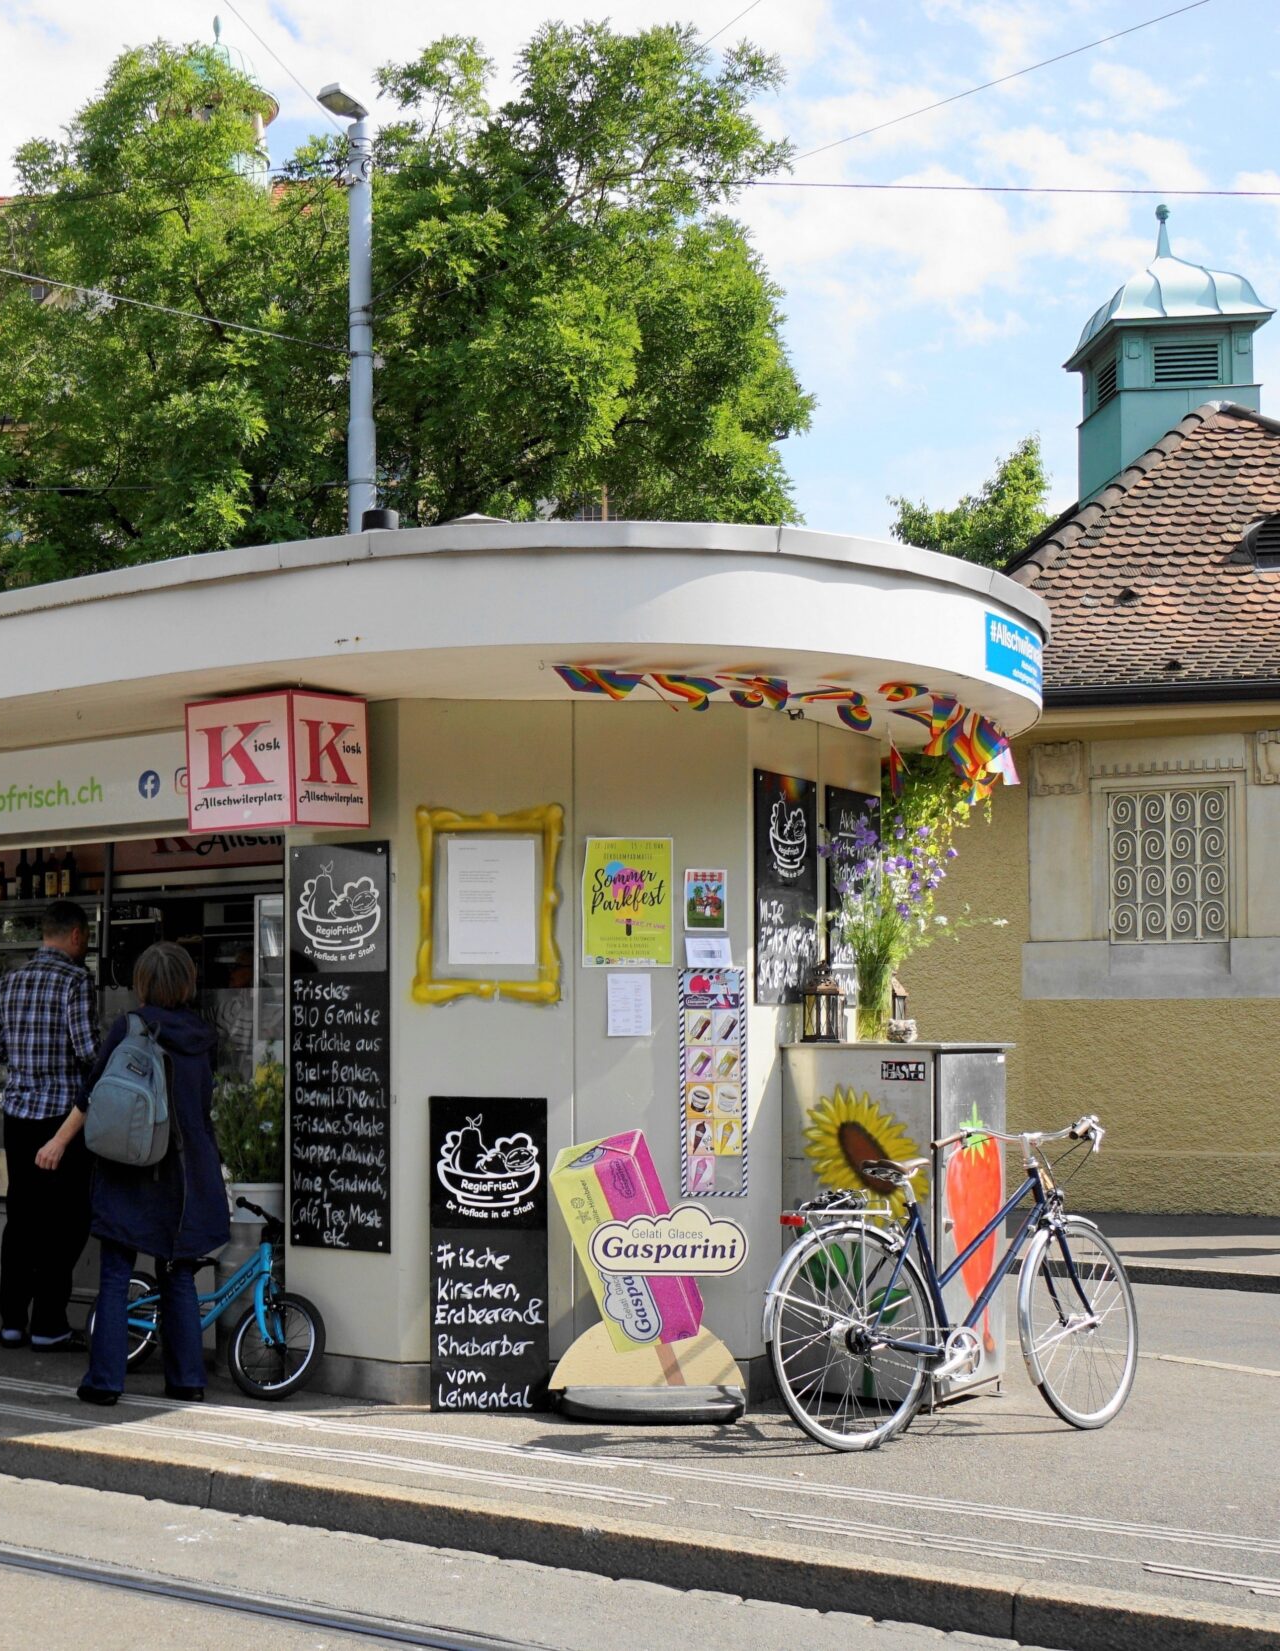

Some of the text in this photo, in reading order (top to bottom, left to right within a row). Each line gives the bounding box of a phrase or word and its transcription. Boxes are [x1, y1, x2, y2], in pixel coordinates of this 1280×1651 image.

[196, 720, 280, 789] Kiosk
[299, 719, 362, 785] Kiosk
[194, 792, 283, 812] Allschwilerplatz
[299, 790, 364, 806] Allschwilerplatz
[592, 868, 657, 893] Sommer
[591, 880, 665, 915] Parkfest
[316, 922, 363, 938] RegioFrisch
[304, 943, 376, 961] Dr Hoflade in dr Stadt
[293, 979, 351, 1000] Frisches
[292, 1002, 381, 1027] BIO Gemüse
[292, 1029, 382, 1054] & Früchte aus
[293, 1113, 385, 1137] Frische Salate
[460, 1178, 519, 1194] RegioFrisch
[349, 1203, 382, 1228] Most
[446, 1199, 535, 1218] Dr Hoflade in dr Stadt
[631, 1228, 704, 1239] Gelati Glaces
[436, 1241, 511, 1270] Frische
[602, 1236, 737, 1264] Gasparini
[437, 1277, 521, 1303] Kirschen,
[612, 1275, 624, 1296] Glace
[434, 1298, 545, 1325] Erdbeeren &
[622, 1275, 652, 1333] Gaspa
[437, 1333, 535, 1357] Rhabarber
[446, 1368, 487, 1385] vom
[438, 1383, 534, 1409] Leimental
